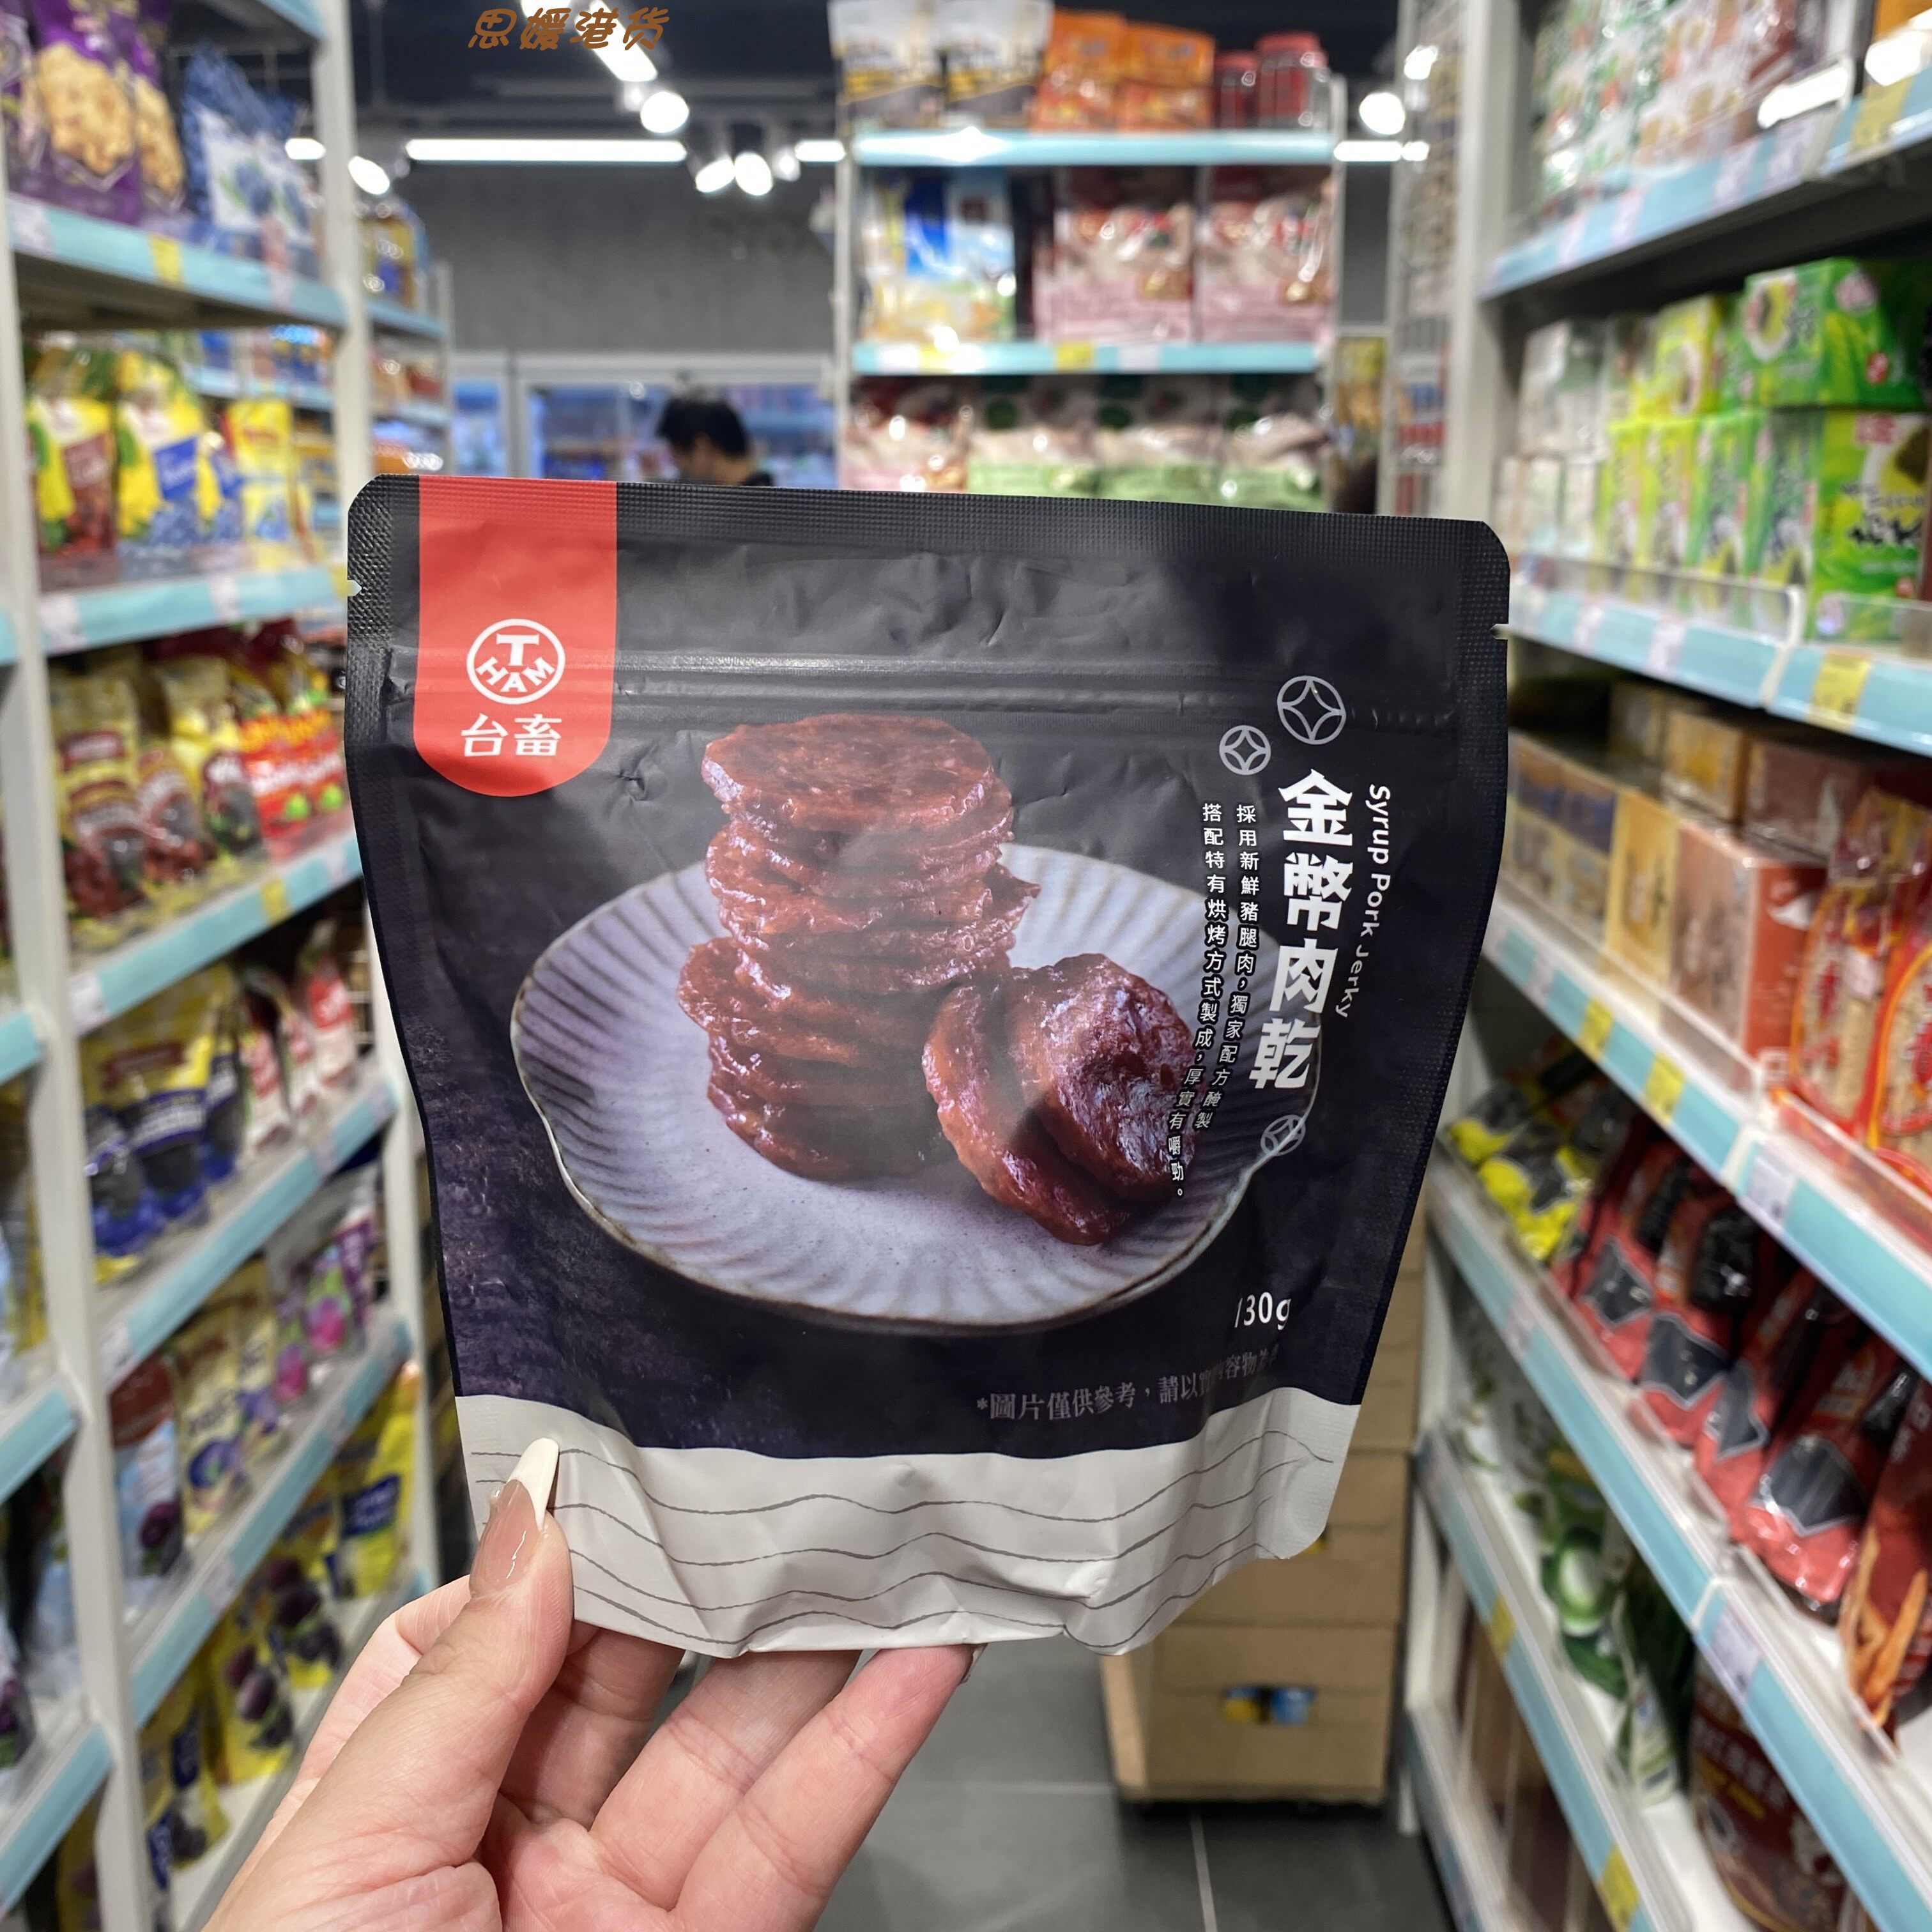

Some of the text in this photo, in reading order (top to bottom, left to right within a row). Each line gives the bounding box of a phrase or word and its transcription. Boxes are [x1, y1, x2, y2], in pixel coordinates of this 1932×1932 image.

[475, 656, 556, 693] HAM
[461, 713, 562, 757] 台畜
[1335, 784, 1391, 1018] Syrup Pork Jerky
[1250, 769, 1353, 1089] 金幣肉乾
[1234, 1291, 1292, 1331] 130g
